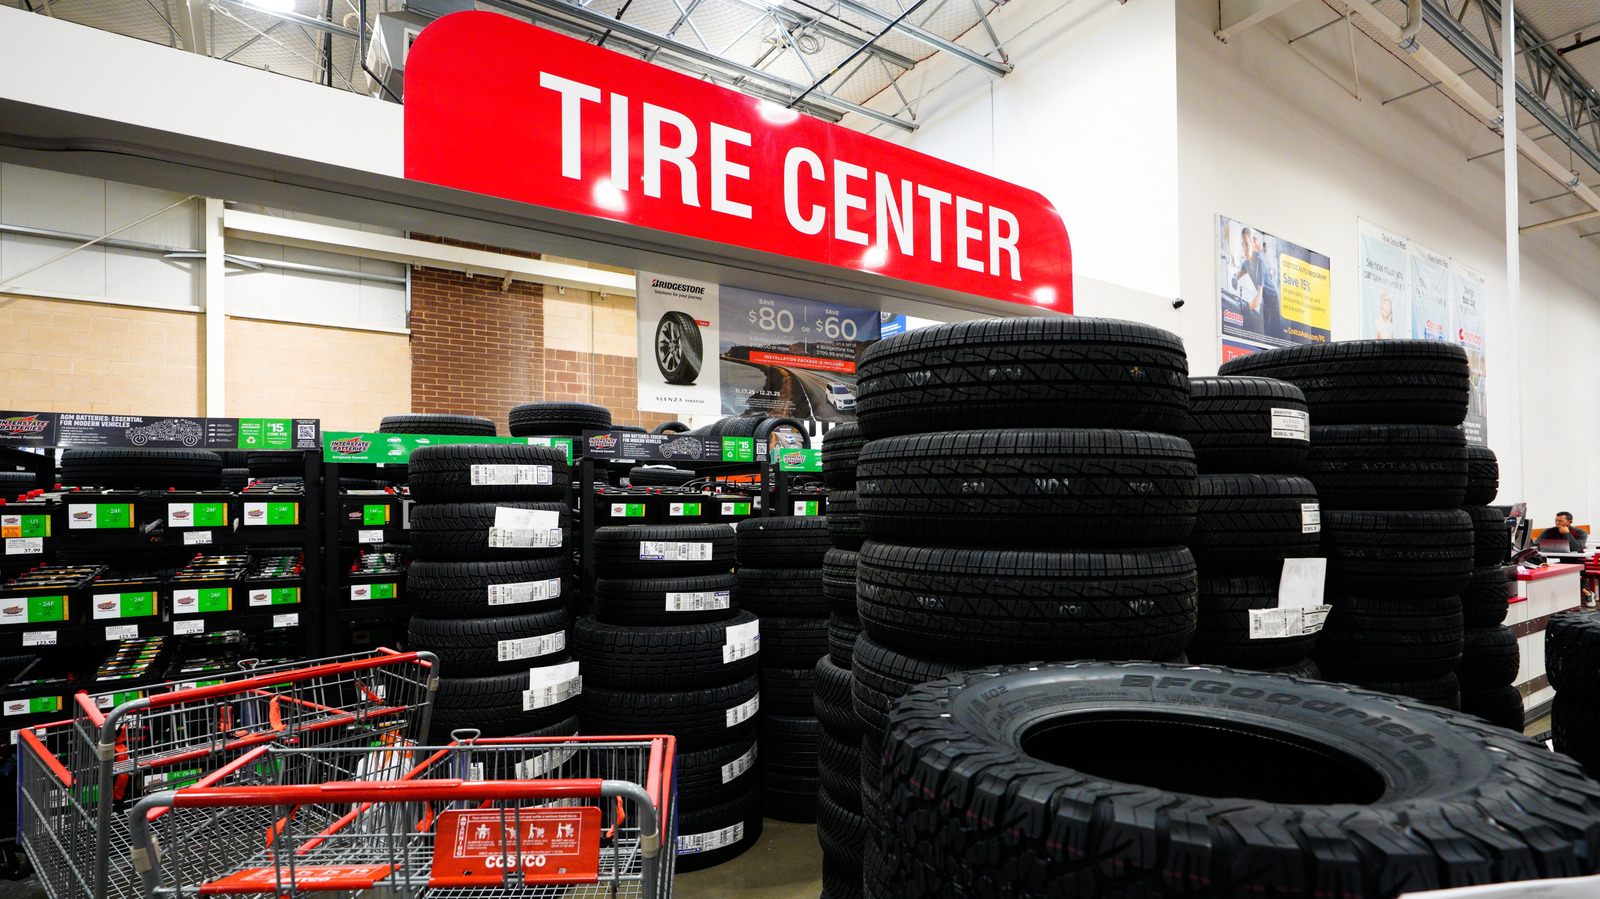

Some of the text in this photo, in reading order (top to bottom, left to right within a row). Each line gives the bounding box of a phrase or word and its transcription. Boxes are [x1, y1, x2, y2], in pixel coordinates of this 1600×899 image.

[539, 71, 1022, 282] TIRE CENTER
[1282, 260, 1299, 271] COSTCO
[1366, 258, 1374, 269] See
[652, 279, 705, 294] BRIDGESTONE
[1283, 273, 1311, 292] Save 15%
[749, 307, 794, 332] $80
[1224, 310, 1243, 322] COSTCO
[816, 317, 857, 340] $60
[1459, 328, 1481, 345] COSTCO
[764, 354, 797, 362] INSTALLATION
[267, 423, 284, 432] $15
[1119, 674, 1438, 751] BFGoodrich
[457, 820, 466, 856] WARNING
